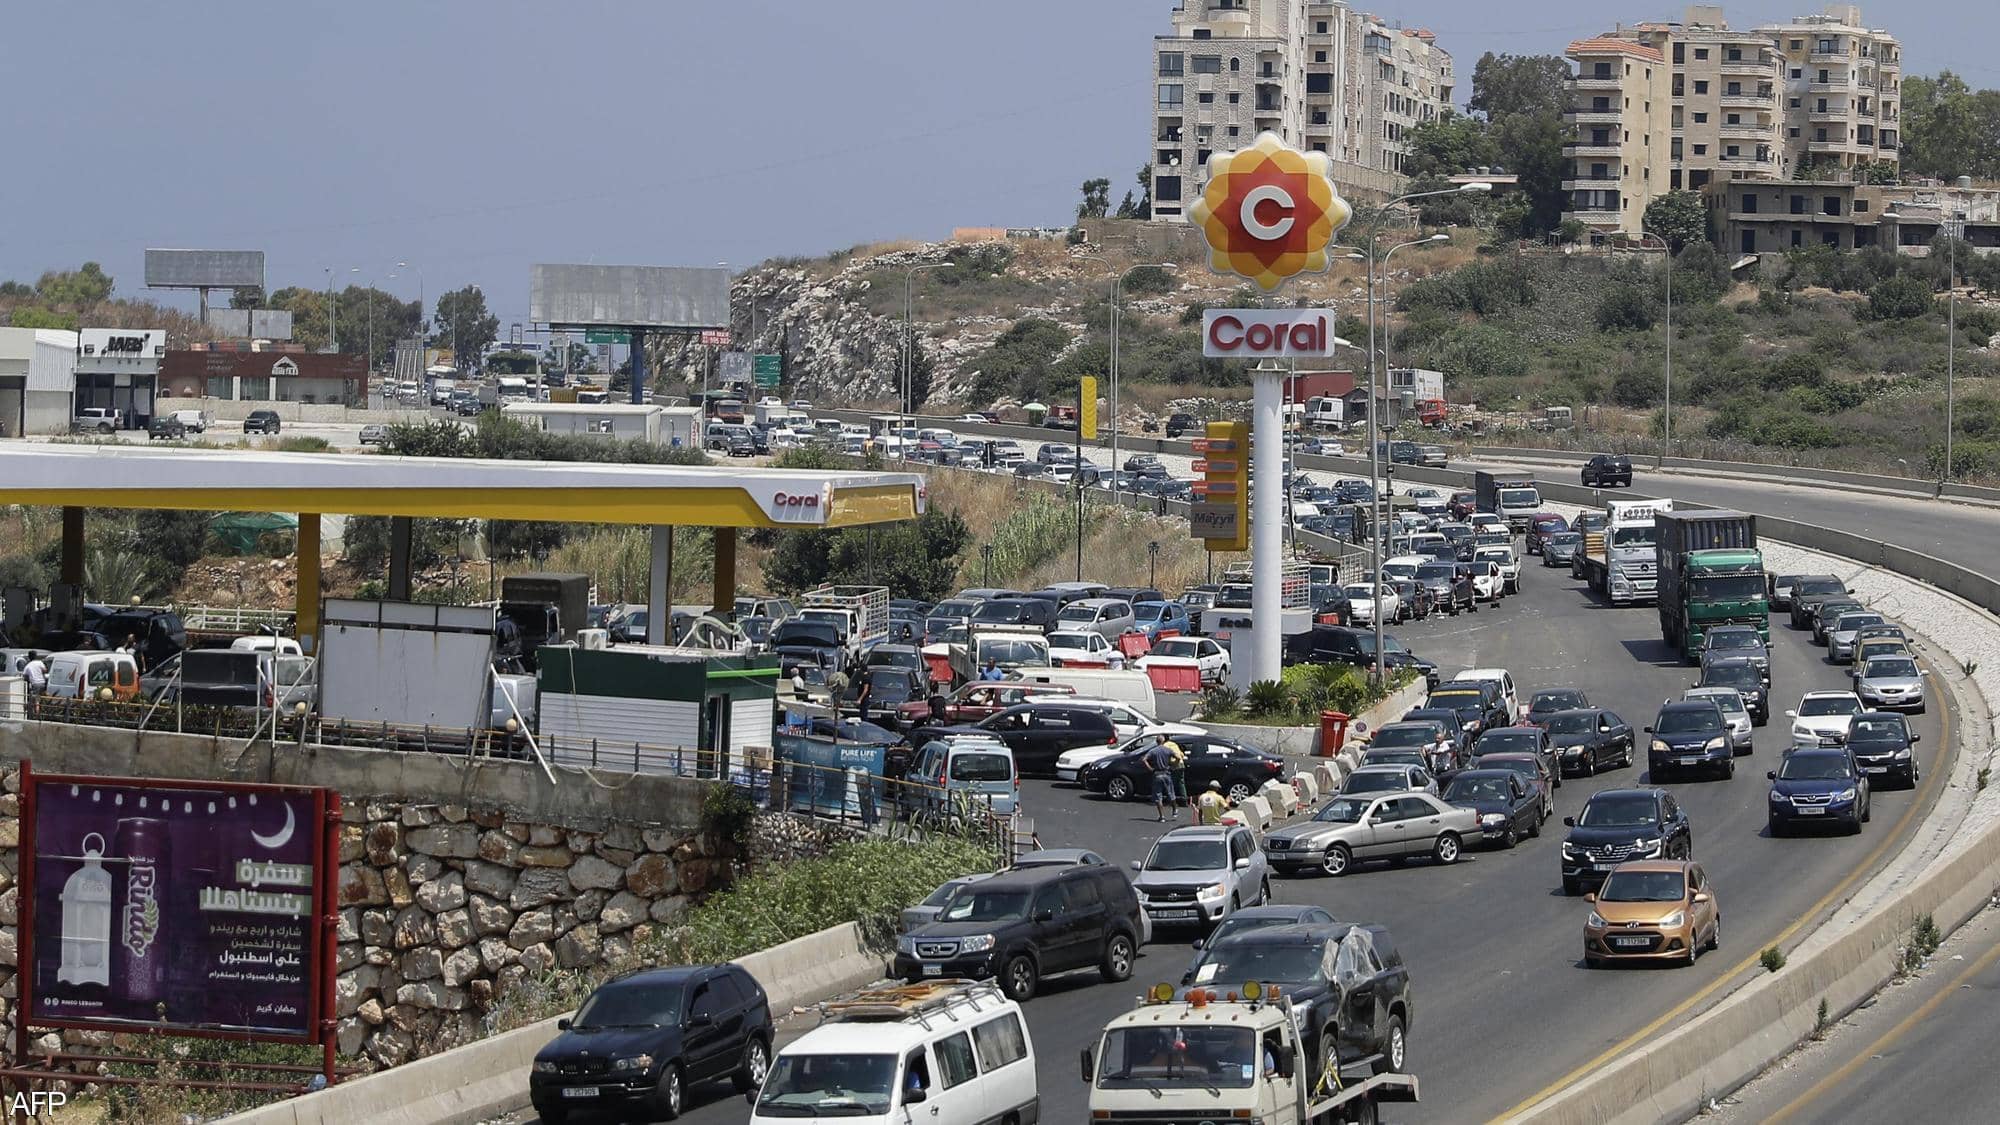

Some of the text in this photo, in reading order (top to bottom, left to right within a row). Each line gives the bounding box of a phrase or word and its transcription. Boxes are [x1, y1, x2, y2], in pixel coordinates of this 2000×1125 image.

[1240, 185, 1296, 241] C
[1209, 314, 1327, 352] Coral
[774, 492, 819, 507] Coral
[840, 749, 859, 757] PURE
[240, 858, 304, 888] سفرة
[128, 866, 156, 957] Rindo
[209, 924, 302, 939] شارك و اربح مع ريندو
[231, 937, 301, 953] سفرة لشخصين
[219, 950, 301, 967] على اسطنبول
[255, 1003, 297, 1016] رمضان كريم
